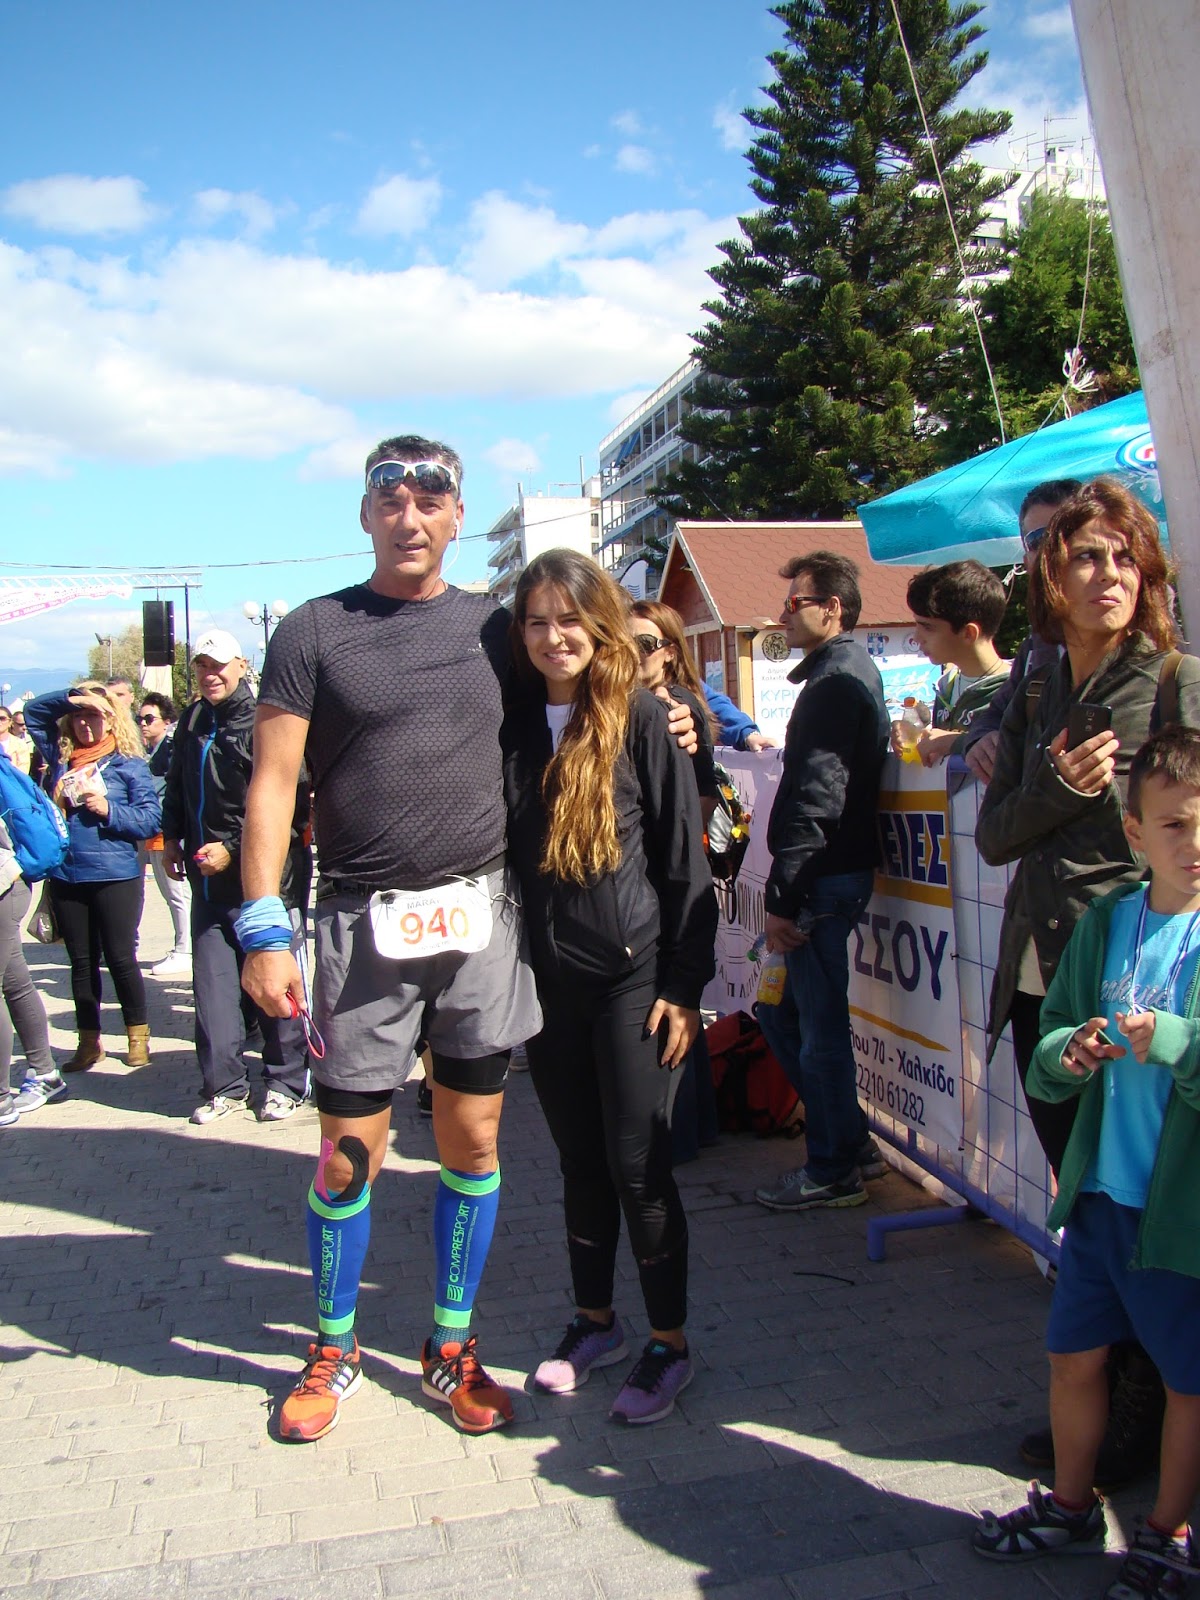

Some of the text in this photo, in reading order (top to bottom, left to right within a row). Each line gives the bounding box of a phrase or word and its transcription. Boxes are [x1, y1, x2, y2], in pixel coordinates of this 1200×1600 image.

[760, 689, 799, 702] ΚΥΡΙ
[760, 706, 792, 719] ΟΚΤΩ
[879, 811, 950, 889] ΕΙΕΣ
[400, 906, 469, 945] 940
[851, 911, 949, 1001] ΣΣΟΥ
[849, 1023, 869, 1056] λου
[872, 1036, 885, 1065] 70
[896, 1047, 955, 1098] Χαλκίδα
[855, 1063, 926, 1127] 2210 61282
